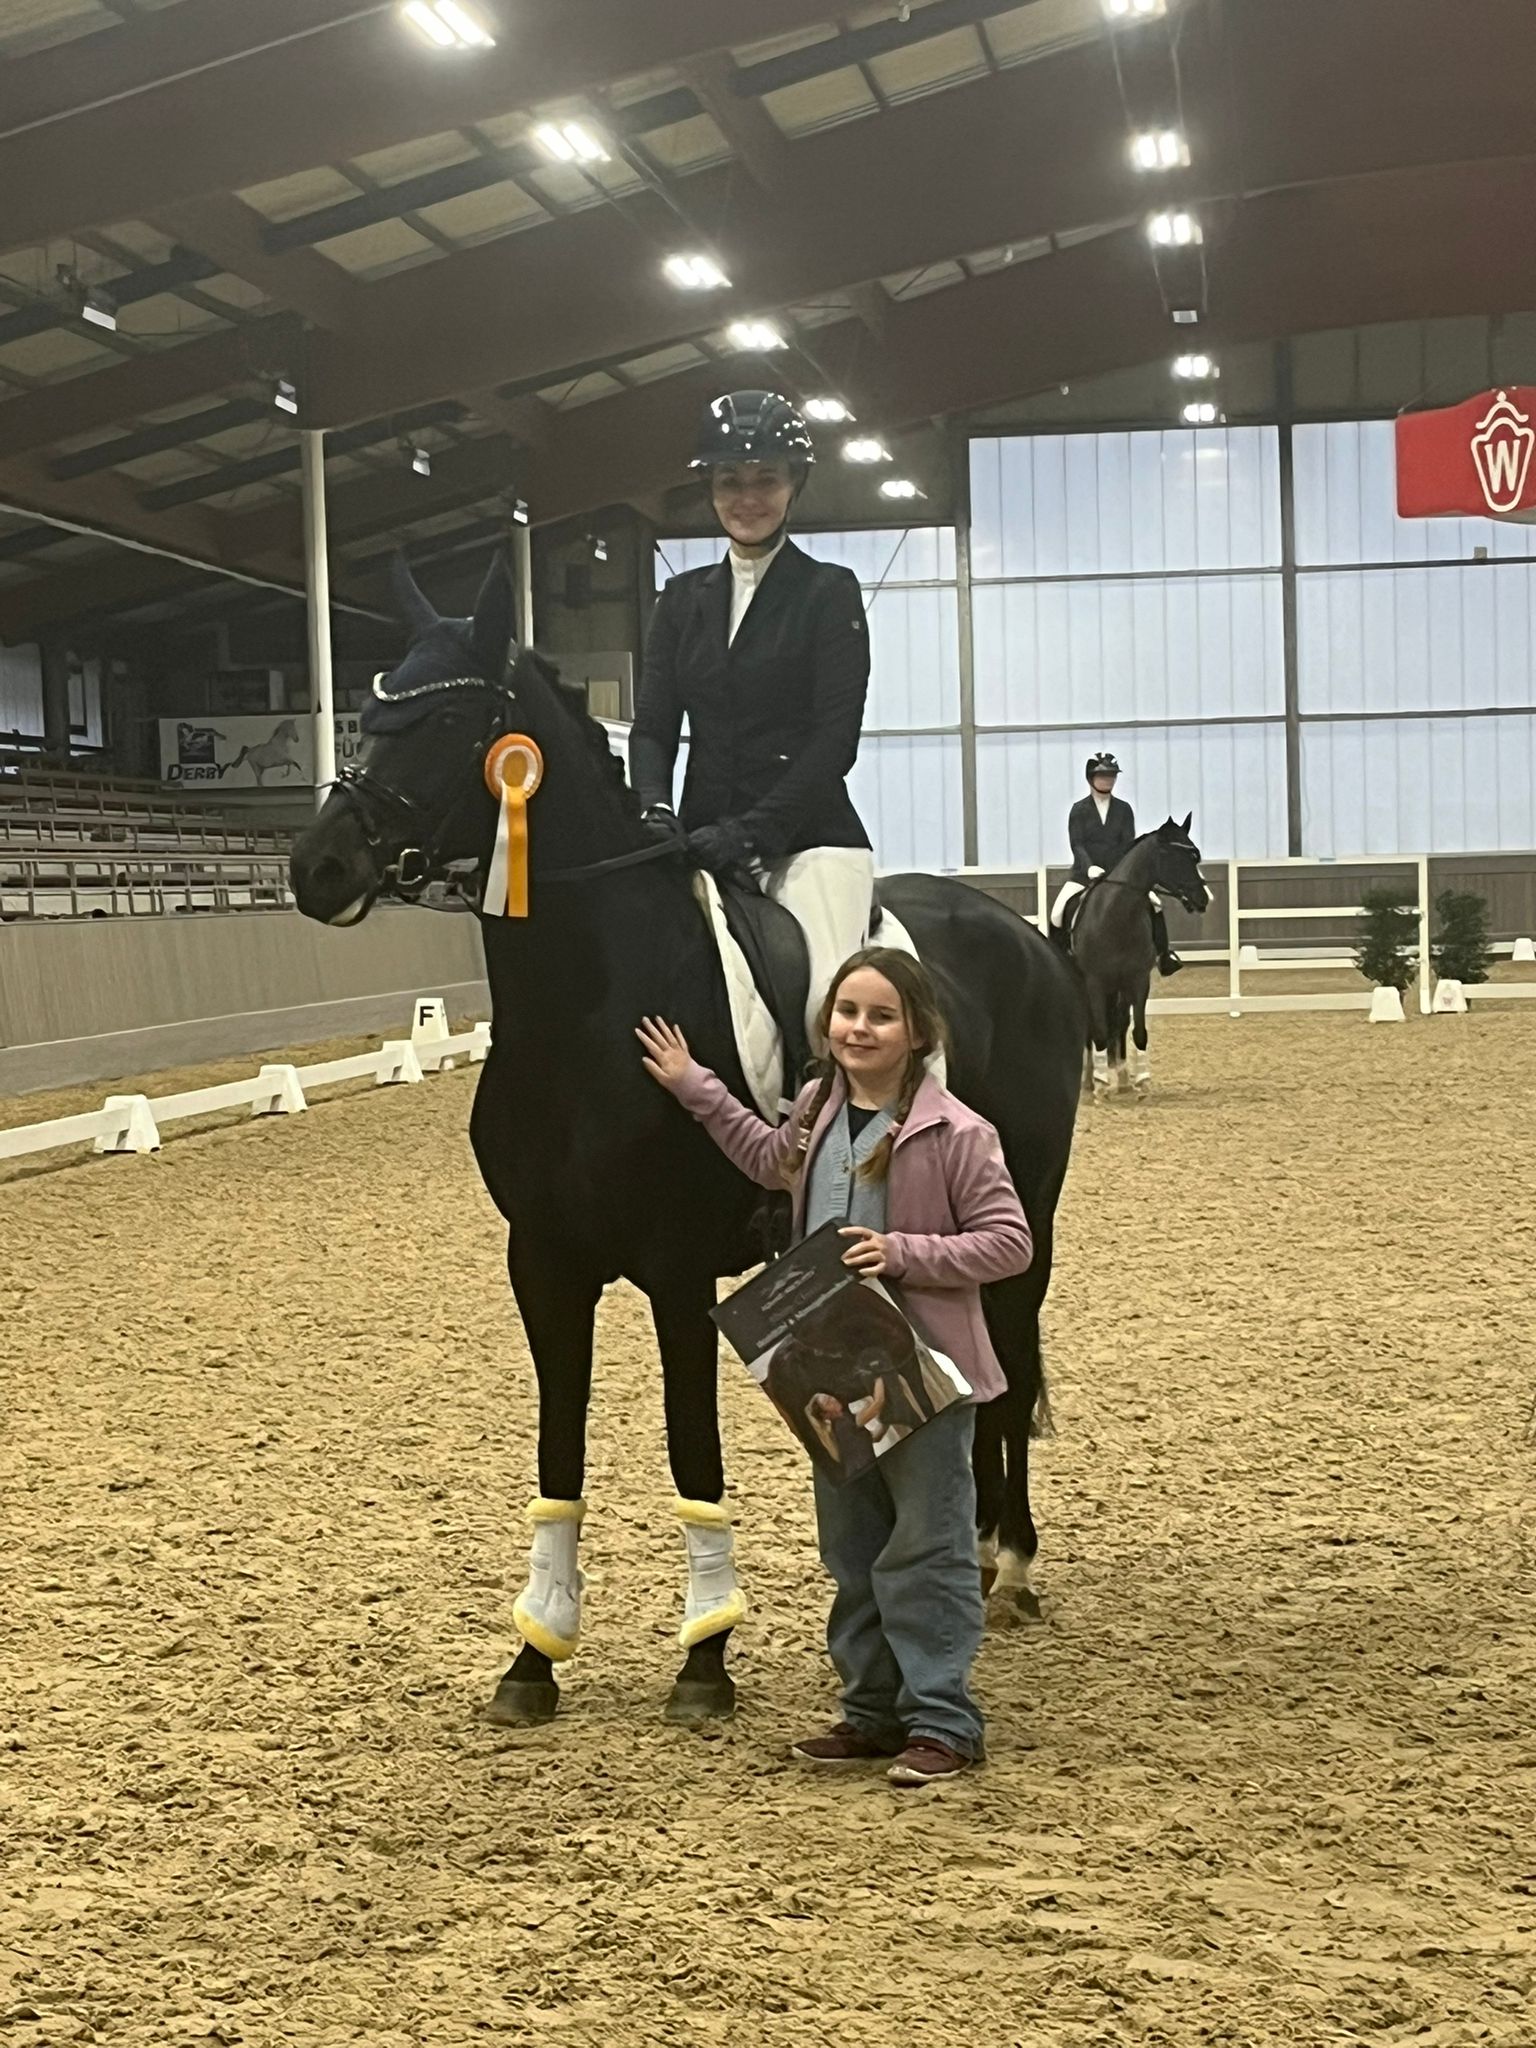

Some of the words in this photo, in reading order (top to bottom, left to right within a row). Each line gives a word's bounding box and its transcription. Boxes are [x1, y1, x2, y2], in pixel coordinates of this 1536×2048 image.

[1484, 440, 1520, 493] W
[167, 763, 230, 781] DERBY
[419, 1006, 435, 1026] F
